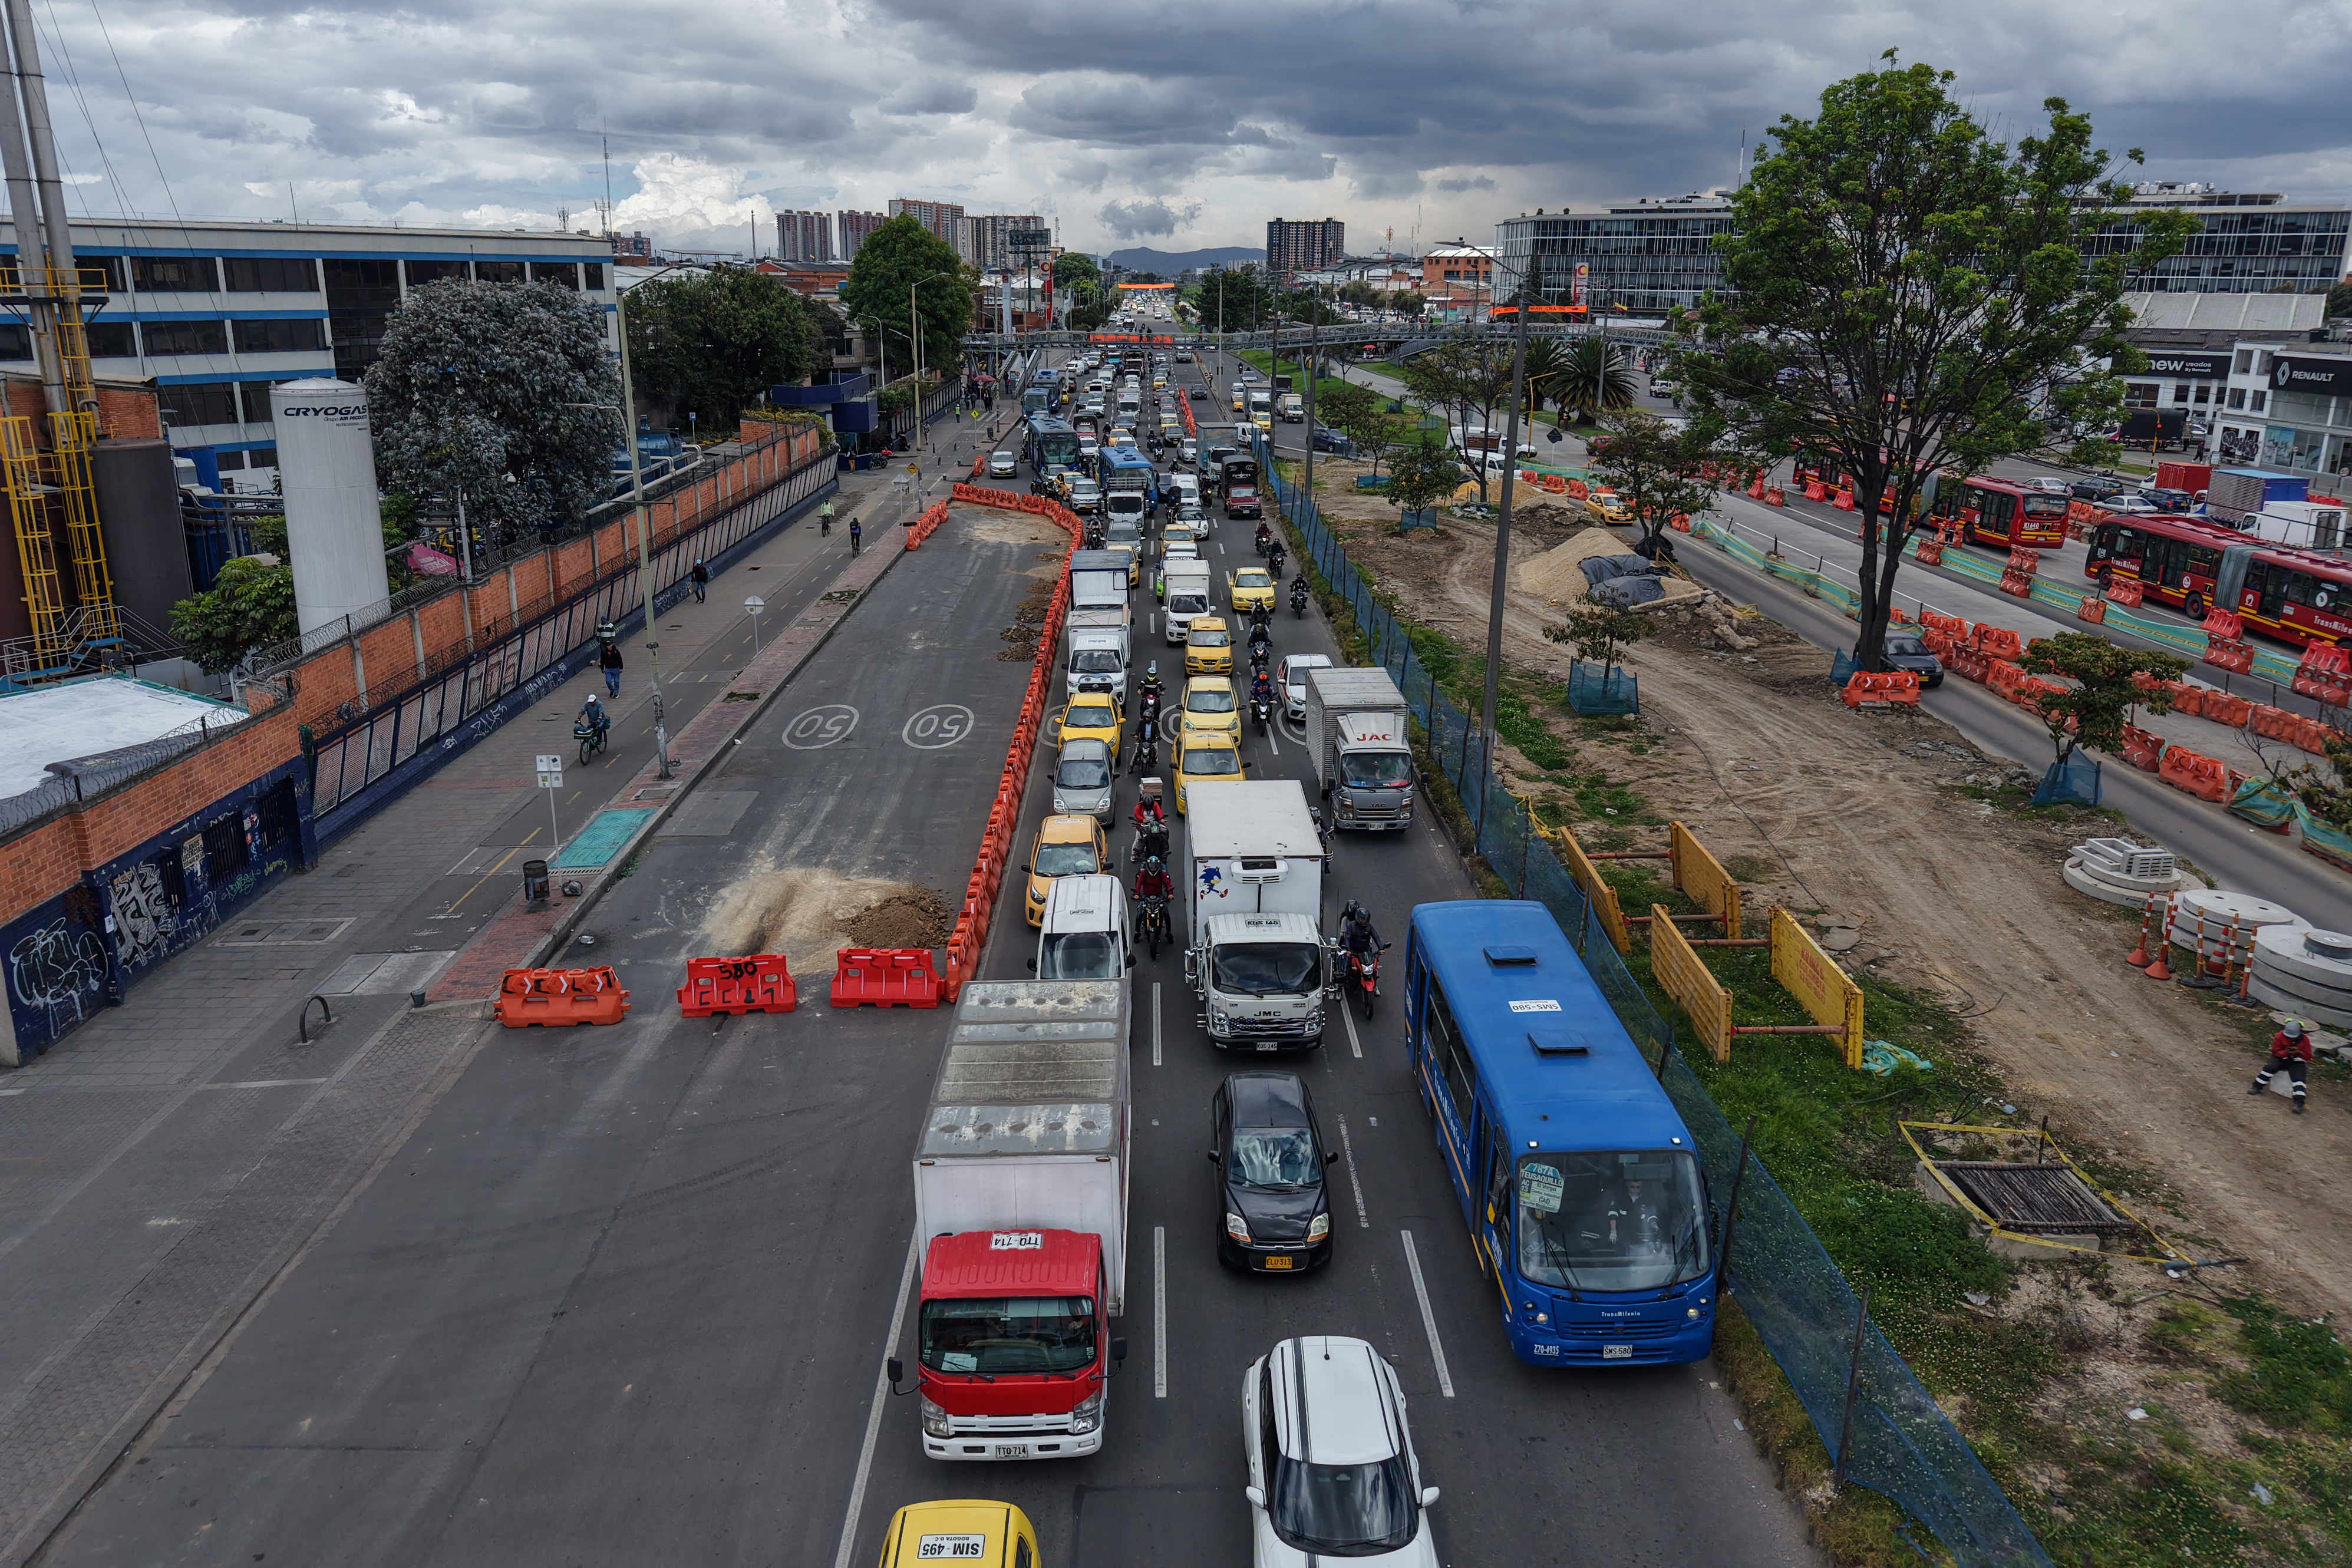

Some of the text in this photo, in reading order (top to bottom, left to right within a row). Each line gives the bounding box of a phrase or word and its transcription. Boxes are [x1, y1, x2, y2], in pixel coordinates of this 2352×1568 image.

[2291, 371, 2334, 382] RENAULT
[284, 404, 367, 417] CRYOGAS
[2111, 556, 2139, 572] TransMilenio
[795, 714, 850, 738] 50
[915, 714, 965, 738] 50
[1357, 733, 1393, 741] JAC
[1434, 1069, 1460, 1148] TransMilenio
[1533, 1164, 1553, 1177] 787A
[1520, 1171, 1562, 1186] TEUSAQUILLO
[1538, 1196, 1551, 1204] CAD
[1533, 1344, 1559, 1355] Z70-4935
